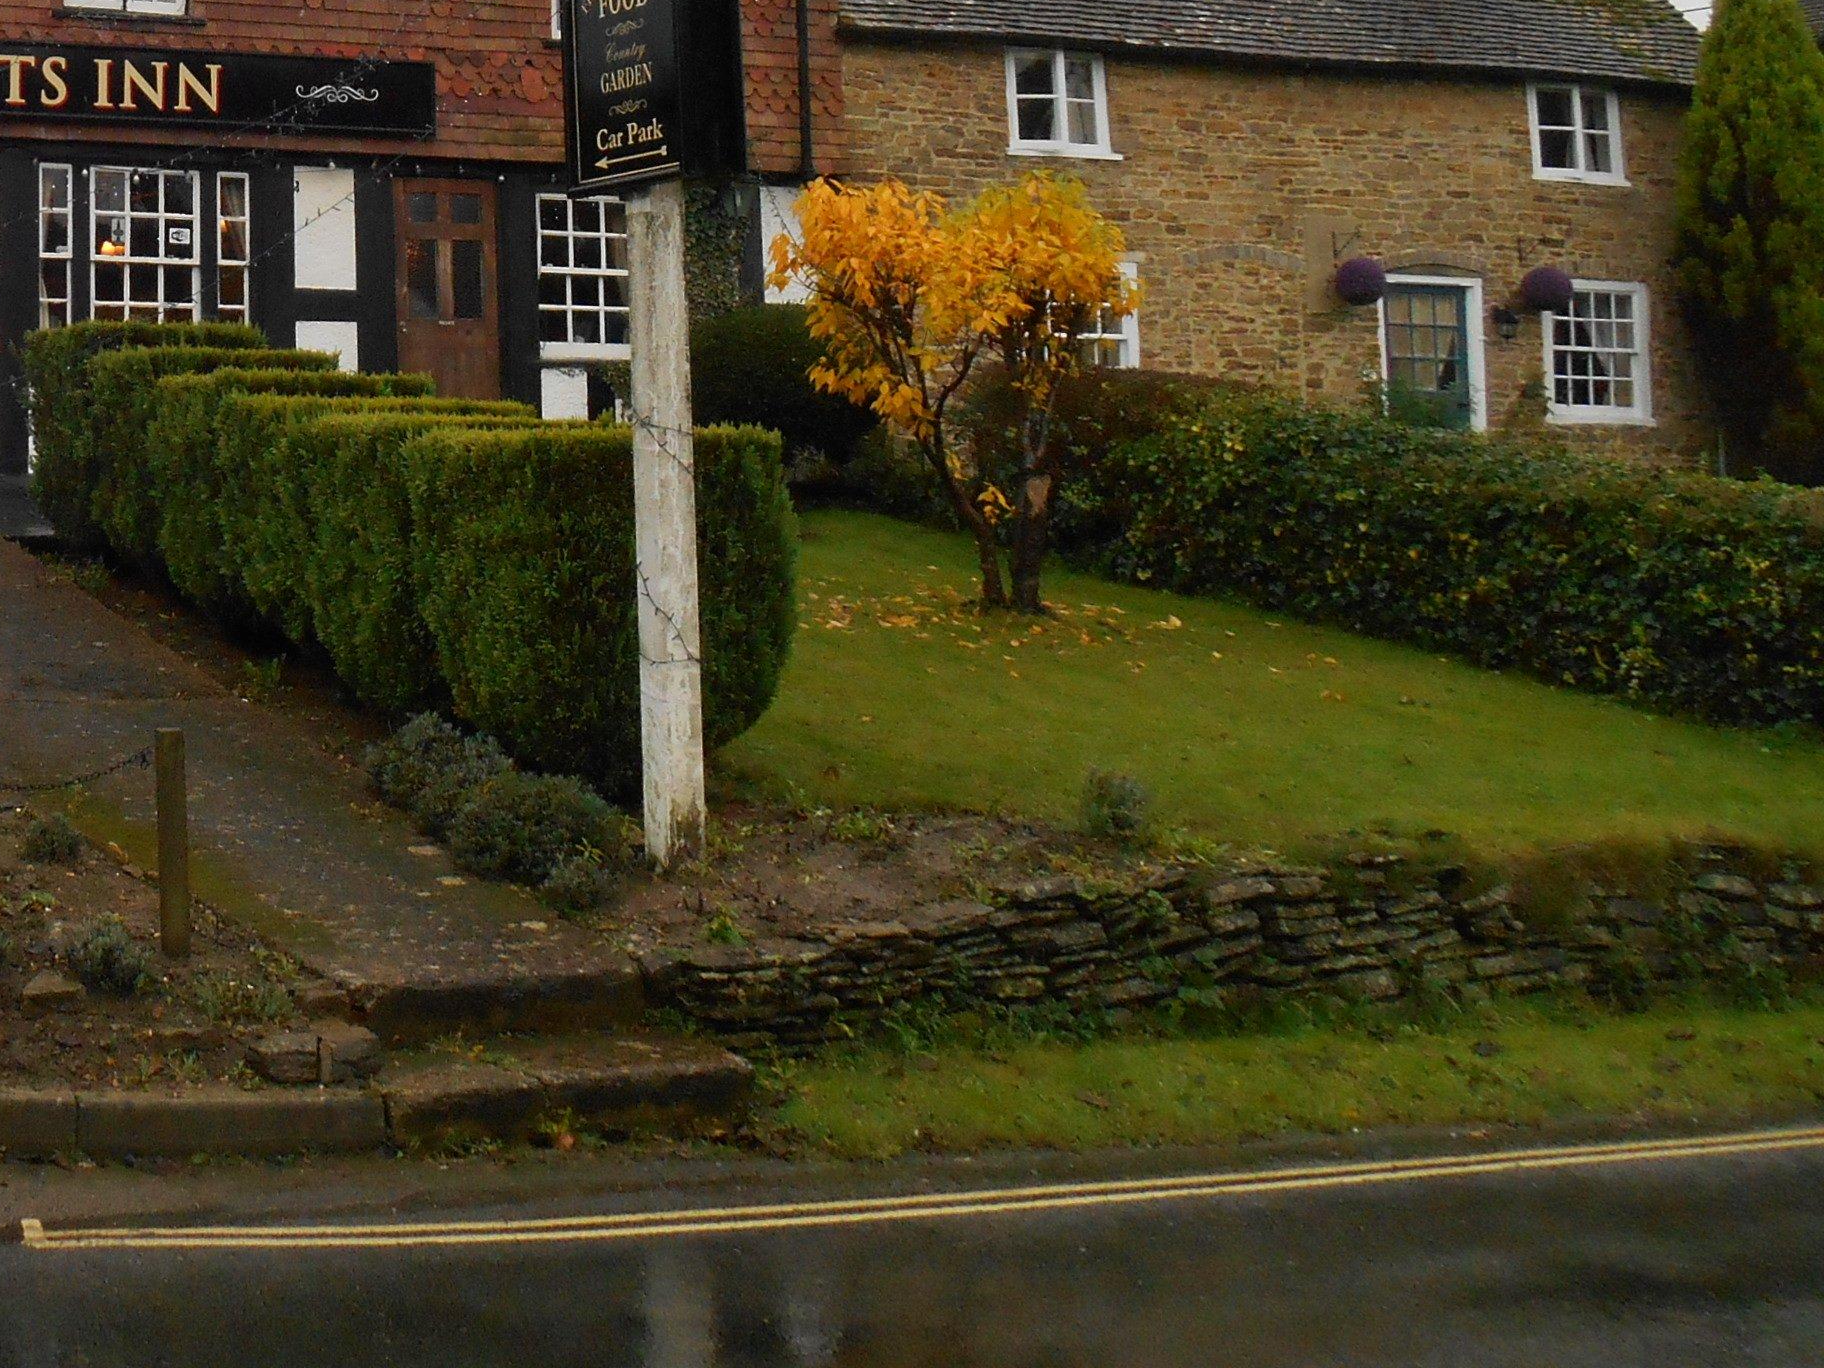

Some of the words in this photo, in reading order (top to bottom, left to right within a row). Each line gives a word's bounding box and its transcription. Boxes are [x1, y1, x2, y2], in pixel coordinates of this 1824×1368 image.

[606, 41, 647, 63] Country
[93, 59, 223, 114] INN
[600, 62, 653, 94] GARDEN
[596, 128, 623, 151] Car
[627, 118, 664, 146] Park
